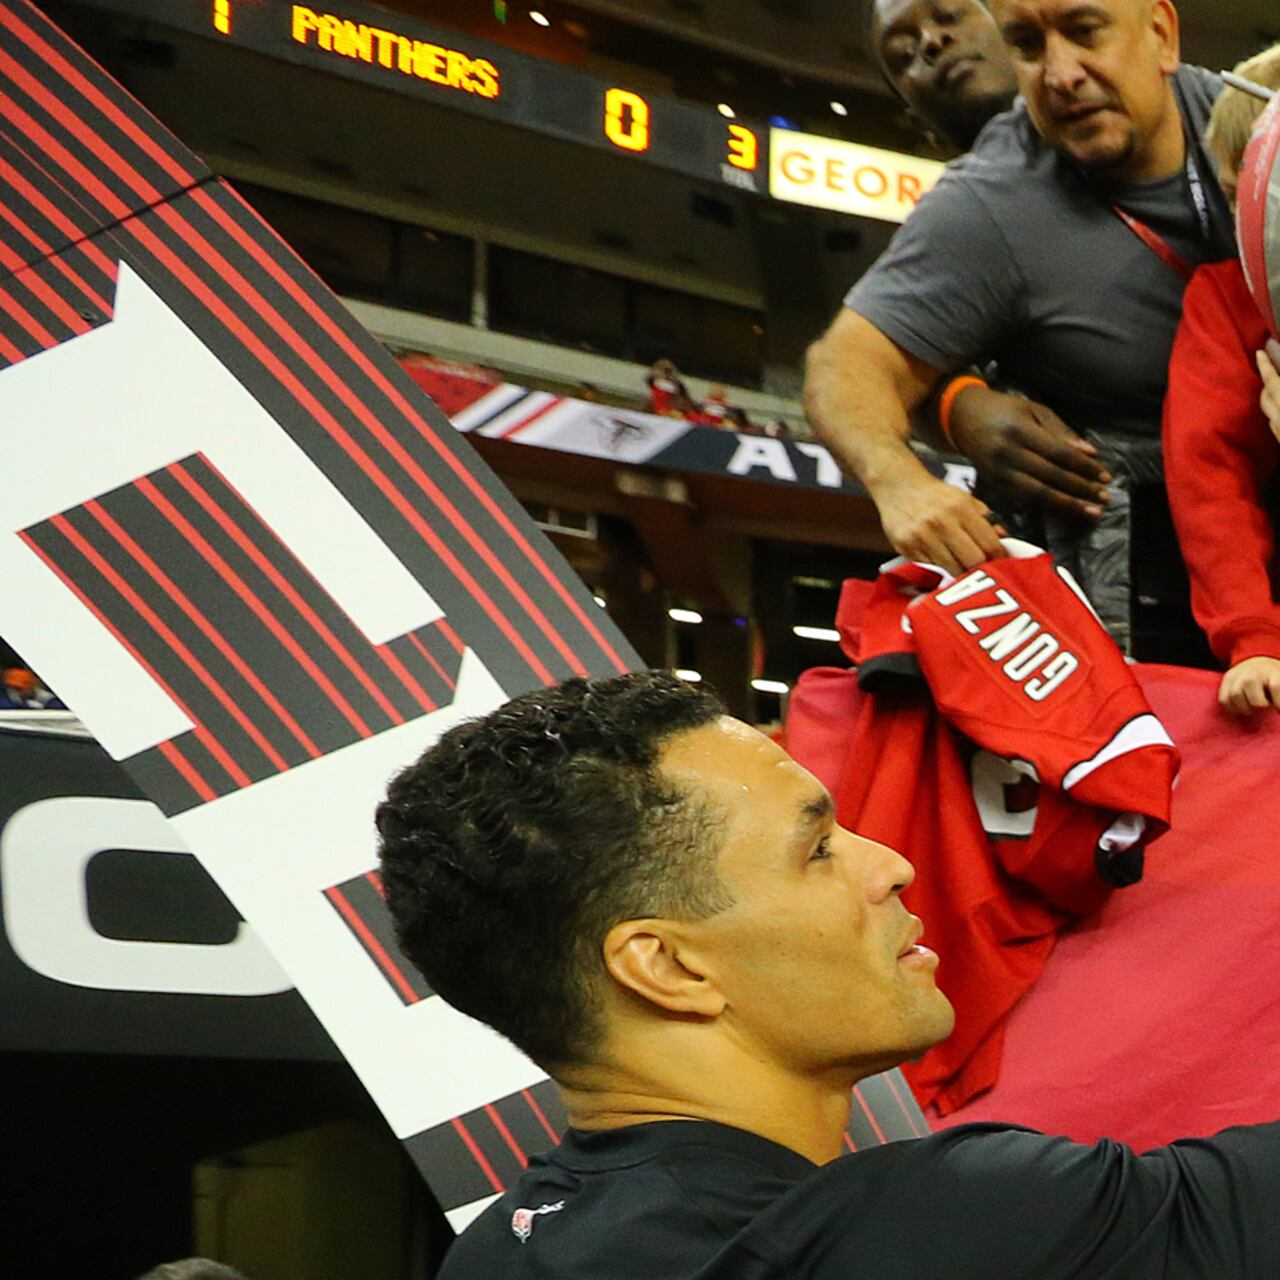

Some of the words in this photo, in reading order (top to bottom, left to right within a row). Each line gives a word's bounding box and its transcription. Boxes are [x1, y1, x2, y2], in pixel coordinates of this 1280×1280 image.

[292, 5, 500, 98] PANTHERS
[605, 87, 649, 151] 0
[727, 123, 757, 170] 3
